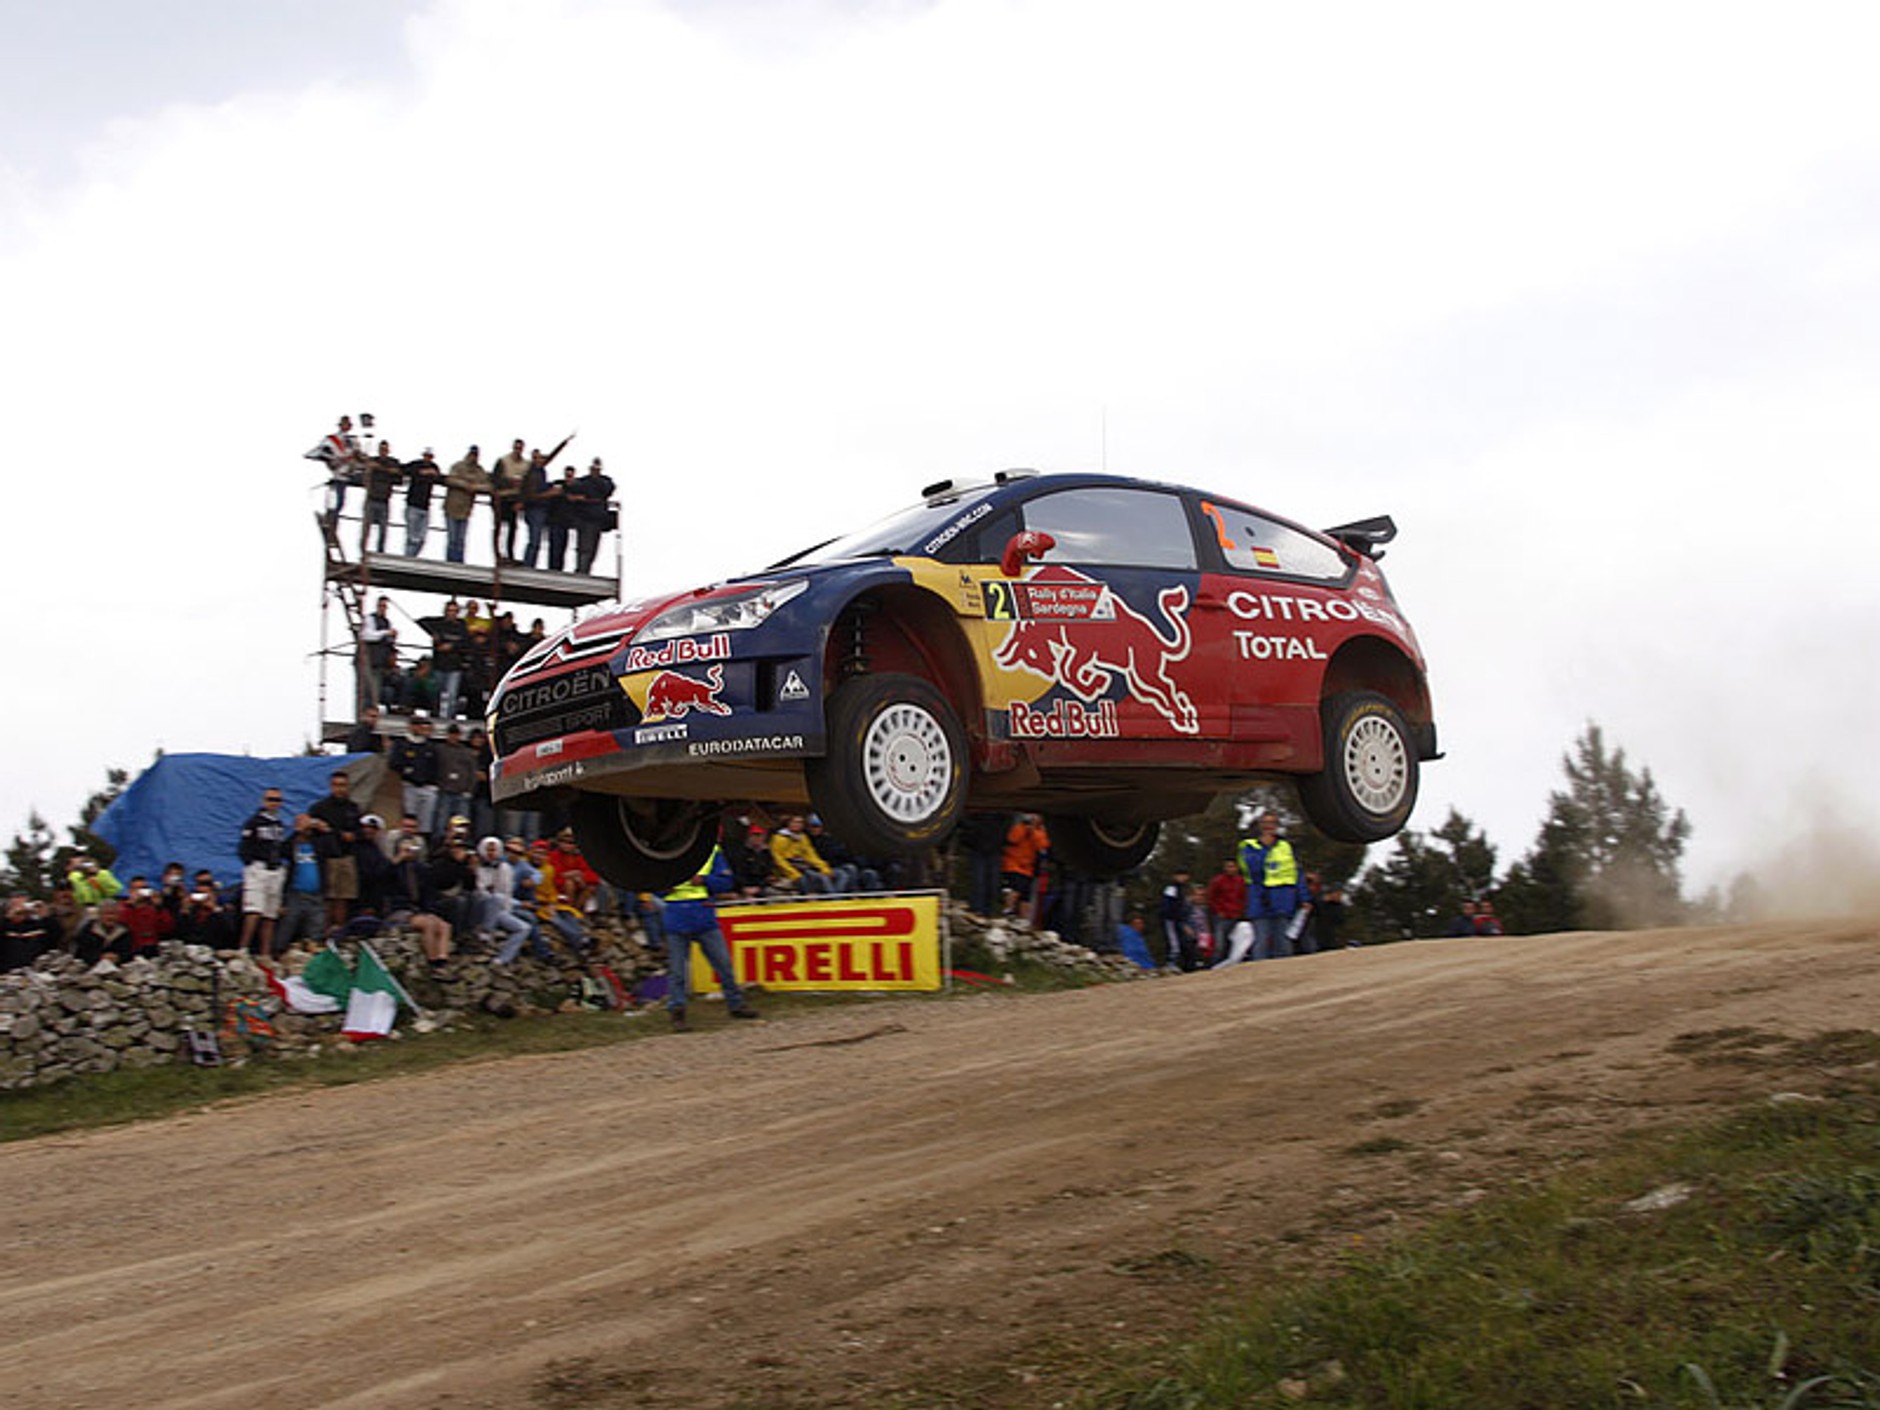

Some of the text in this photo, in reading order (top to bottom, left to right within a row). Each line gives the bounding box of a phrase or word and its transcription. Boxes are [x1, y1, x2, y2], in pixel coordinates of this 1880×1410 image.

[988, 583, 1010, 619] 2
[1027, 587, 1056, 603] Rally
[1031, 602, 1088, 617] Sardegna
[625, 632, 732, 672] Red Bull
[1232, 631, 1328, 660] TOTAL
[502, 670, 611, 714] CITROËN
[1009, 698, 1120, 738] Red Bull
[634, 724, 688, 745] PIRELLI
[688, 735, 804, 756] EURODATACAR
